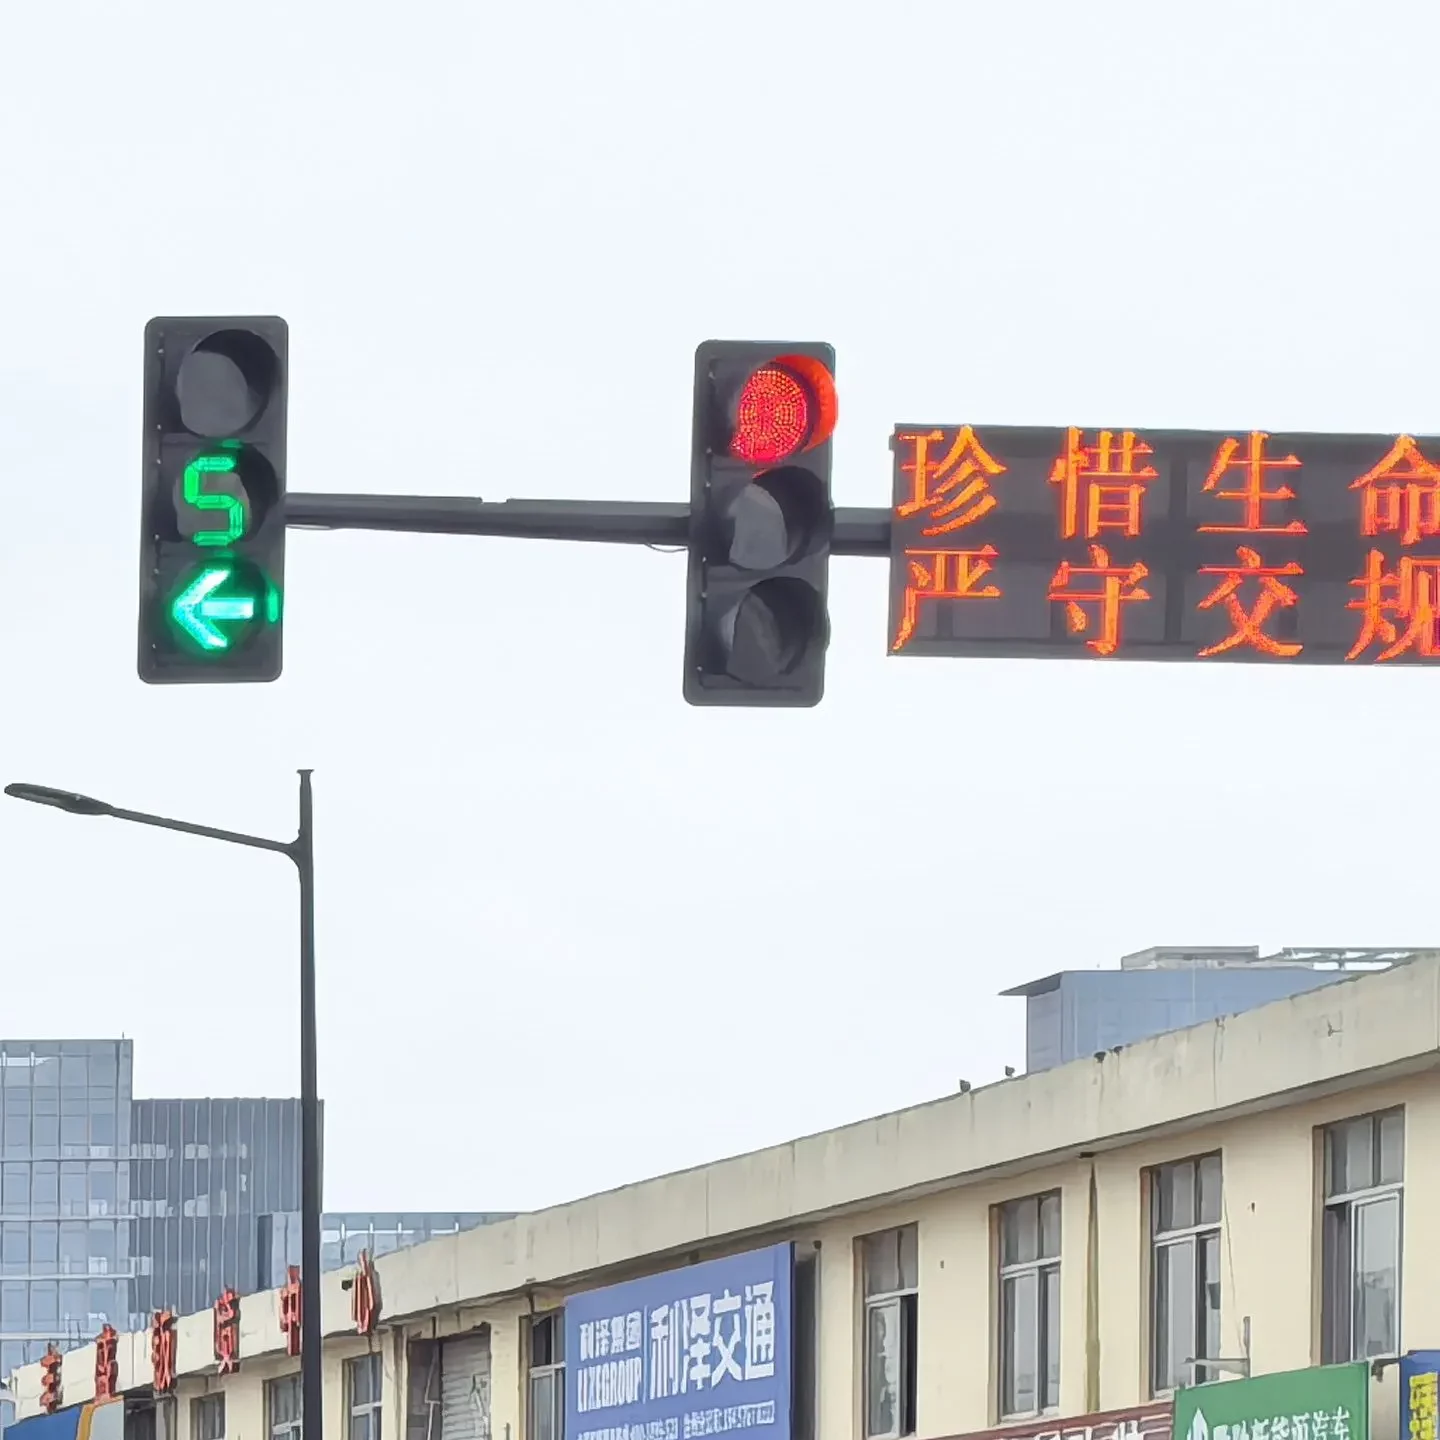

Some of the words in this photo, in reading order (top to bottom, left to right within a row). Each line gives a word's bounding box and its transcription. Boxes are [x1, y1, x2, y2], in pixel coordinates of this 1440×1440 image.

[184, 456, 244, 547] 5
[894, 425, 1440, 545] 珍惜生命
[892, 544, 1440, 661] 严守交规
[650, 1281, 775, 1400] 利泽交通
